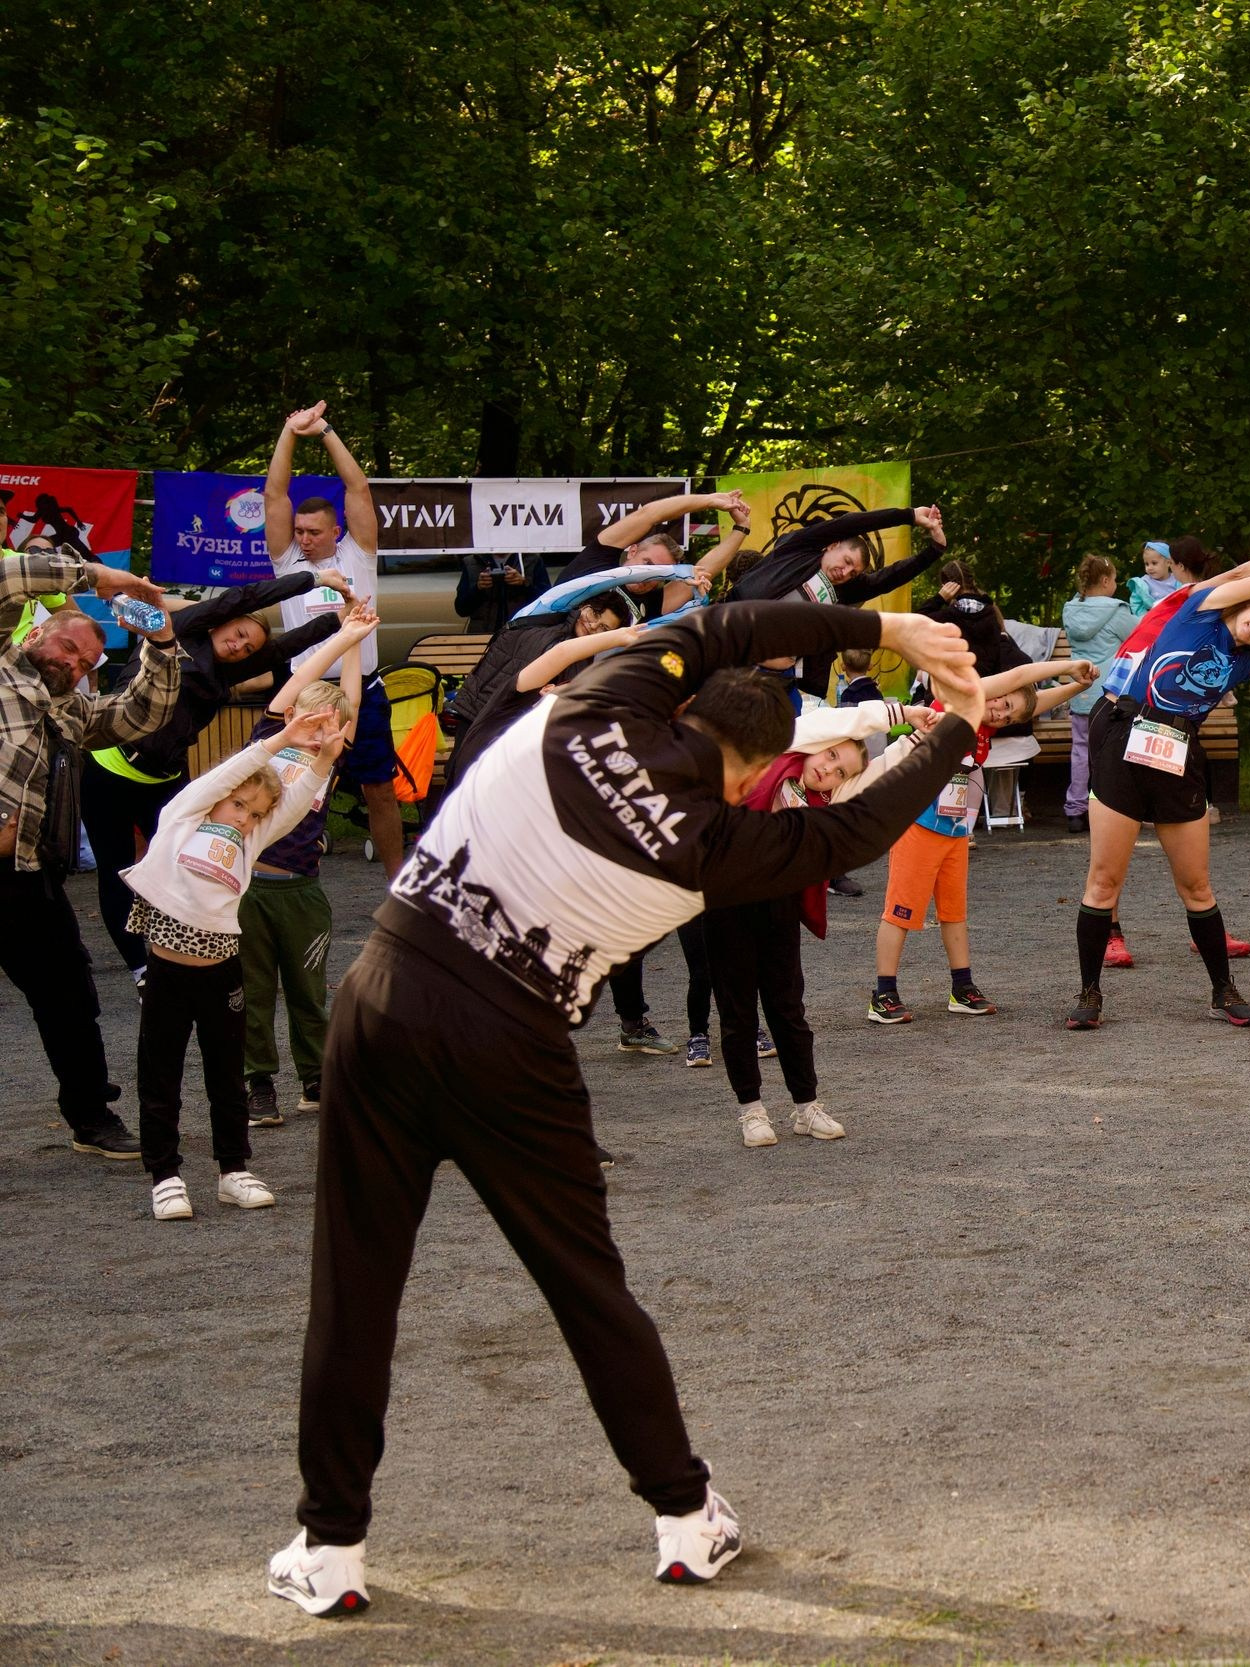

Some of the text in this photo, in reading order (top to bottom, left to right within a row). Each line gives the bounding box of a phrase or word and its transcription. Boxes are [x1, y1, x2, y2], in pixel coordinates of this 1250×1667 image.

[0, 474, 41, 486] ЕНСК
[379, 504, 455, 528] УГЛИ
[489, 503, 563, 526] УГЛИ
[598, 503, 668, 526] УГ
[321, 588, 338, 602] 16
[1140, 723, 1163, 734] КРОСС
[1145, 736, 1174, 759] 168
[567, 735, 663, 860] VOLLEYBALL
[199, 824, 232, 837] КРОСС
[207, 838, 237, 870] 53
